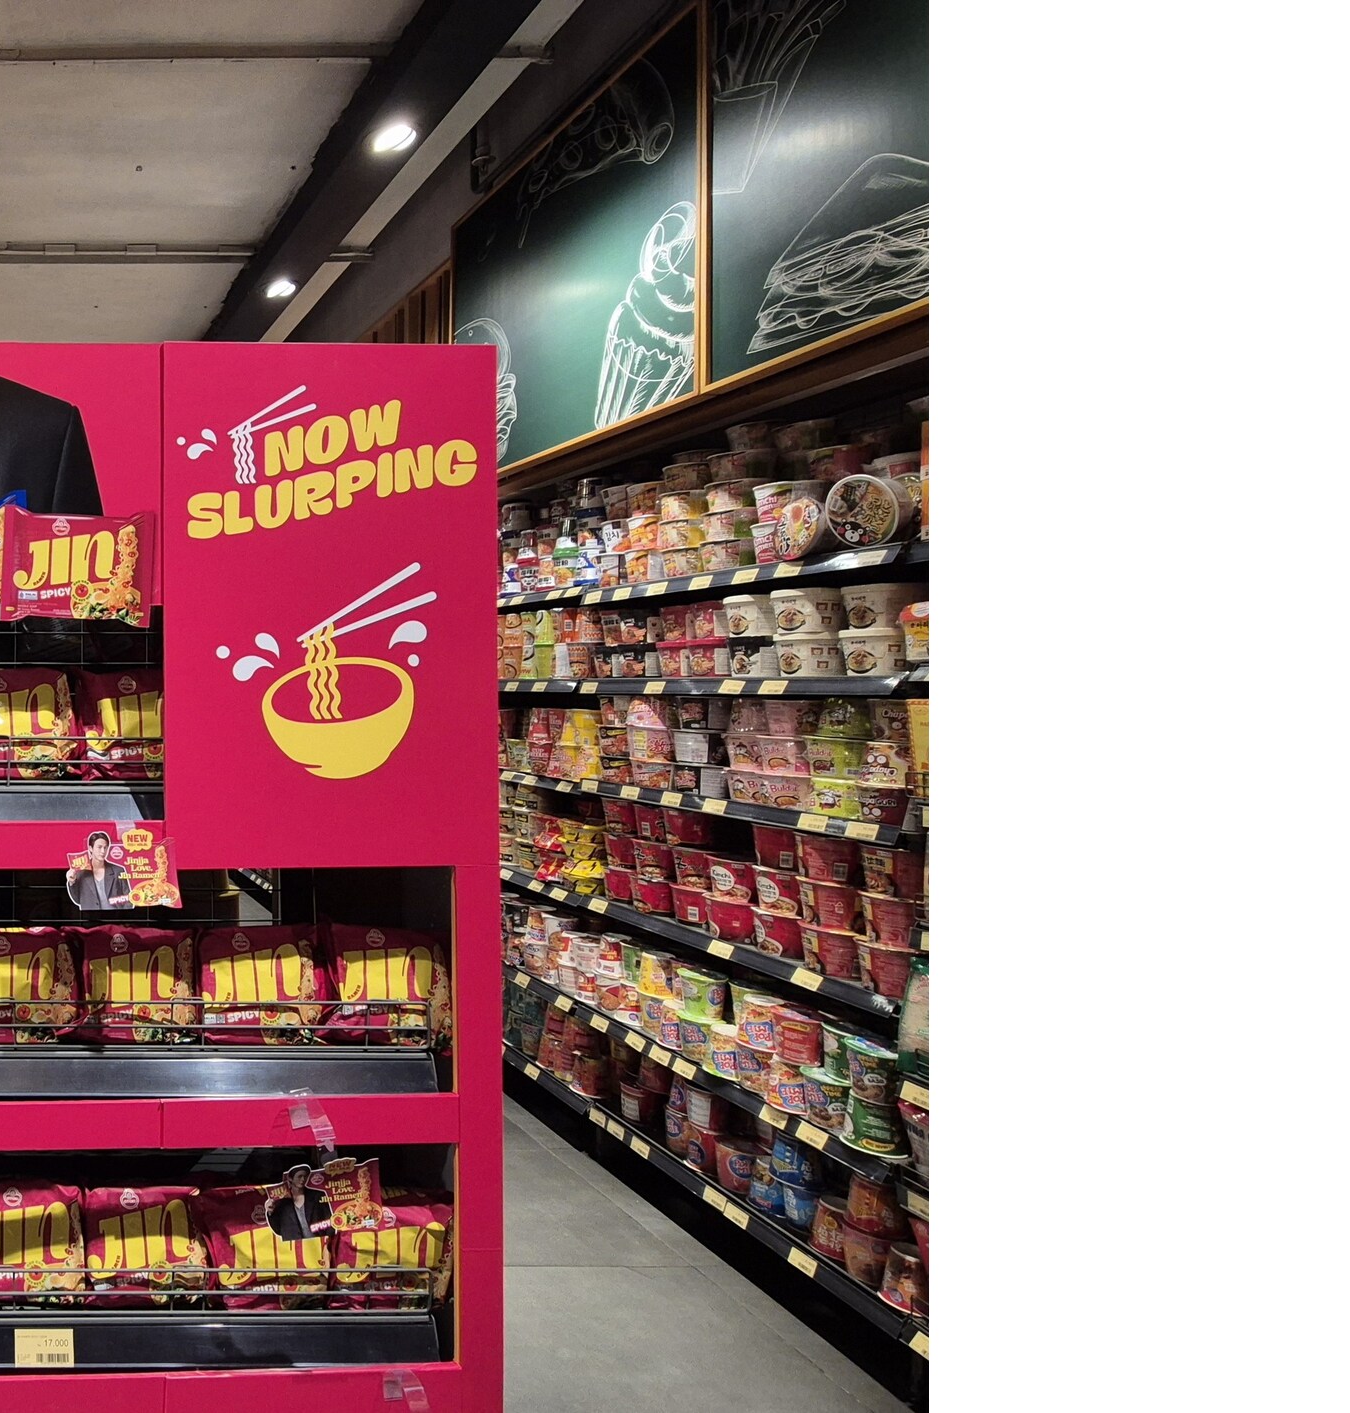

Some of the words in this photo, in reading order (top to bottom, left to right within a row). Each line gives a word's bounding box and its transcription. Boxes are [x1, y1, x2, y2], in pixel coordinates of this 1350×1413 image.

[264, 399, 402, 477] NOW
[187, 439, 478, 539] SLURPING
[40, 586, 71, 599] SPICY
[126, 834, 148, 843] NEW
[124, 857, 149, 866] Jinjja
[227, 1010, 260, 1023] SPICY
[756, 1032, 772, 1042] POP
[720, 1060, 739, 1071] POP
[786, 1094, 805, 1104] POP
[325, 1178, 351, 1189] Jinjja
[332, 1186, 355, 1195] Love.
[319, 1195, 333, 1203] Jin
[333, 1191, 363, 1201] Ramen
[310, 1220, 331, 1233] SPICY
